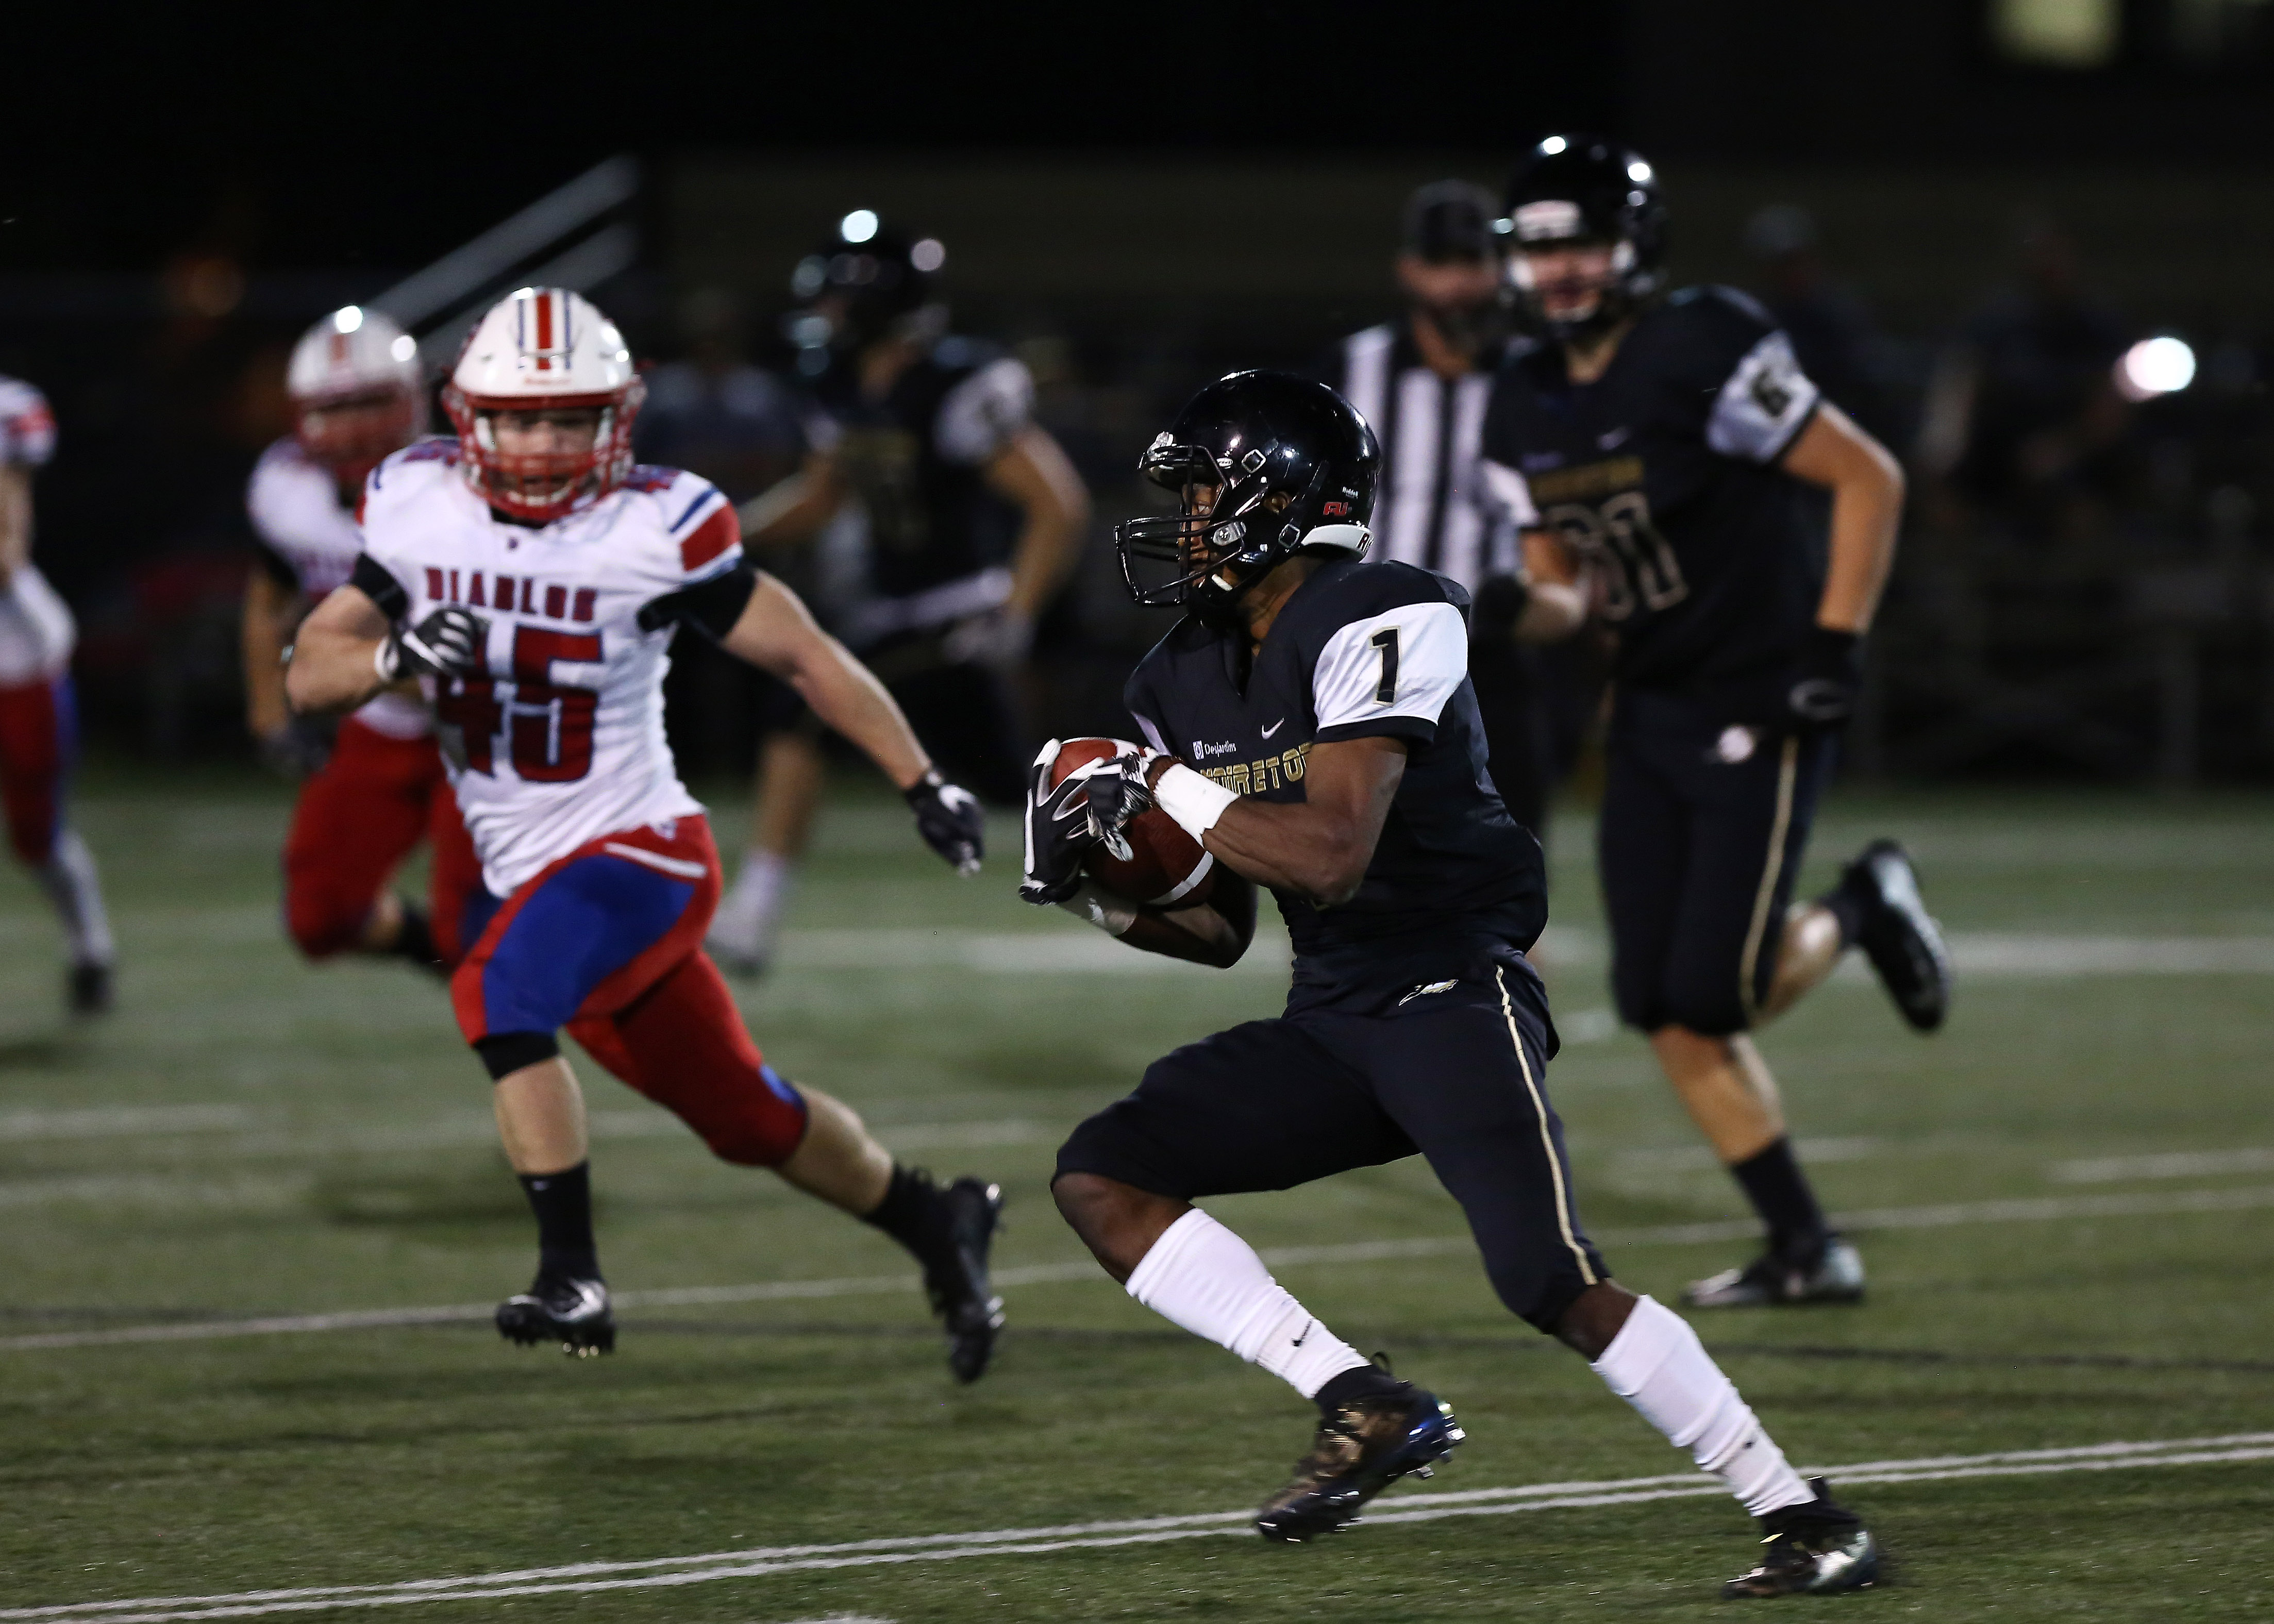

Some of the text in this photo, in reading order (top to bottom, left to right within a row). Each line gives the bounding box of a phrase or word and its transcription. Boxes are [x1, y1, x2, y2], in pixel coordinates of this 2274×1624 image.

[1369, 625, 1402, 708] 1
[436, 621, 604, 783] 45
[1204, 740, 1236, 758] Desjardins
[1252, 756, 1280, 793] ET
